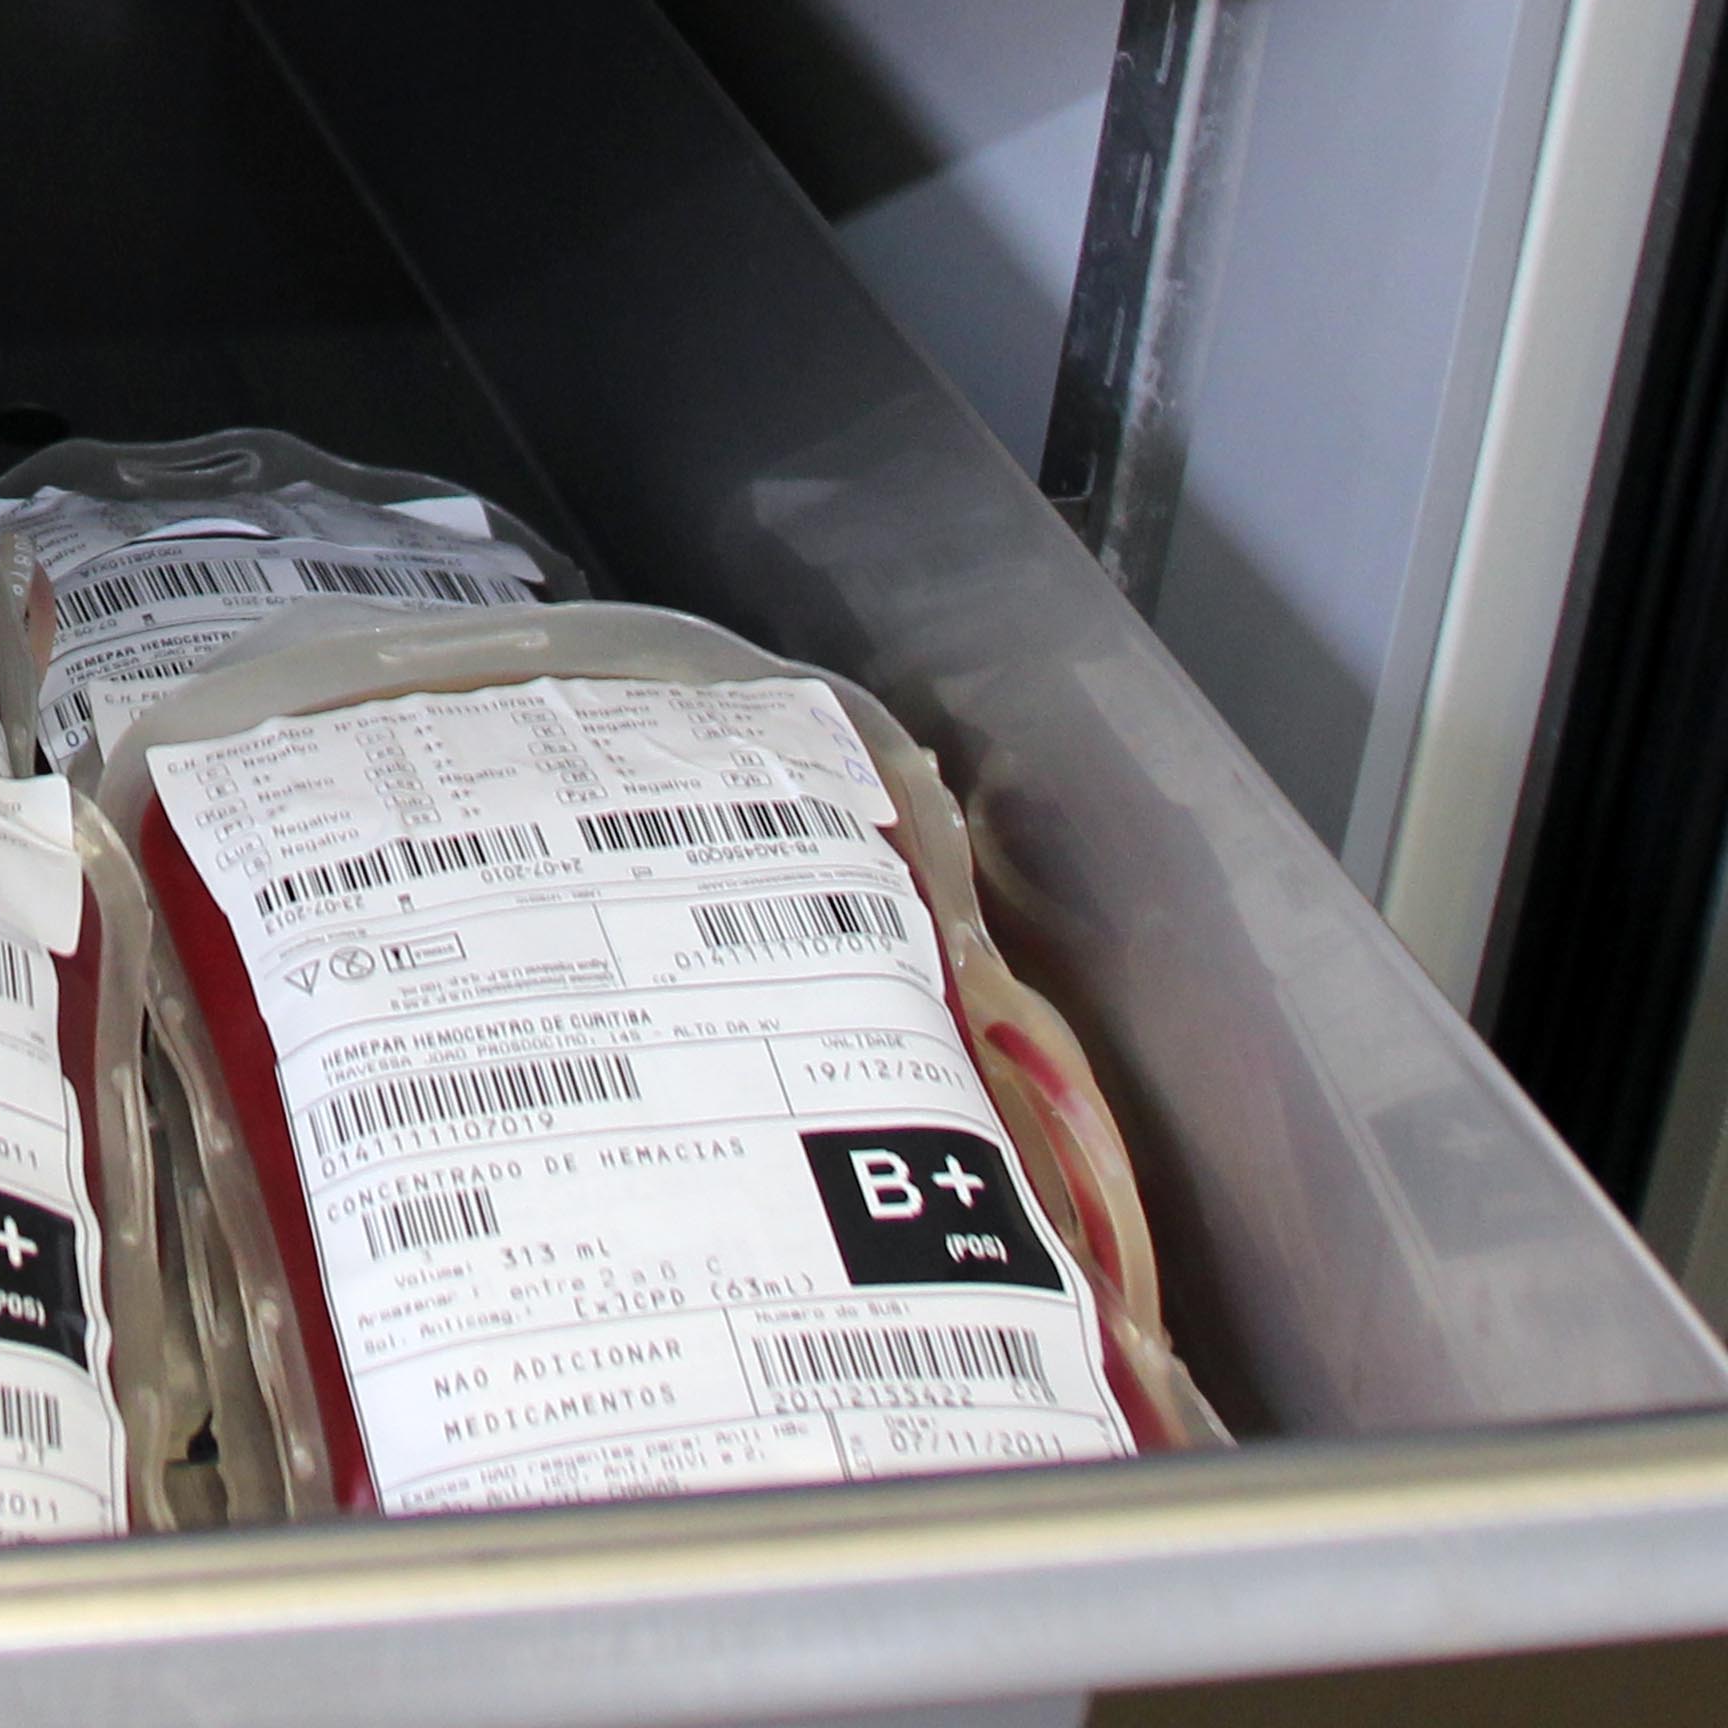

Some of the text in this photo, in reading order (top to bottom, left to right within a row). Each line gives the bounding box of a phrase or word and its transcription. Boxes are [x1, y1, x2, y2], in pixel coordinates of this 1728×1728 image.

[65, 644, 137, 676] HEMEPAR
[206, 725, 315, 764] FENOTIPADO
[243, 741, 319, 769] Negativo
[440, 765, 518, 787] Negativo
[623, 778, 703, 797] Negativo
[272, 808, 353, 841] Negativo
[280, 827, 361, 860] Negativo
[686, 841, 821, 865] PB-3AG456Q0B
[480, 856, 583, 885] 24-07-2010
[675, 935, 894, 969] 0141111107019
[321, 1008, 654, 1069] HEMEPAR HEMOCENTRO DE CURITIBA
[673, 1022, 719, 1038] ALTO
[804, 1060, 968, 1089] 19/12/2011
[320, 1111, 556, 1180] 0141111107019
[328, 1136, 747, 1224] CONCENTRADO DE HEMACIAS
[848, 1147, 984, 1221] B+
[502, 1244, 554, 1271] 313
[577, 1239, 611, 1261] mL
[946, 1234, 1009, 1265] (POS)
[508, 1274, 585, 1301] entre
[711, 1273, 814, 1302] (63mL)
[433, 1337, 683, 1402] NAO ADICIONAR
[443, 1383, 679, 1445] MEDICAMENTOS
[771, 1384, 974, 1417] 20112155422
[891, 1421, 1065, 1459] 07/11/2011
